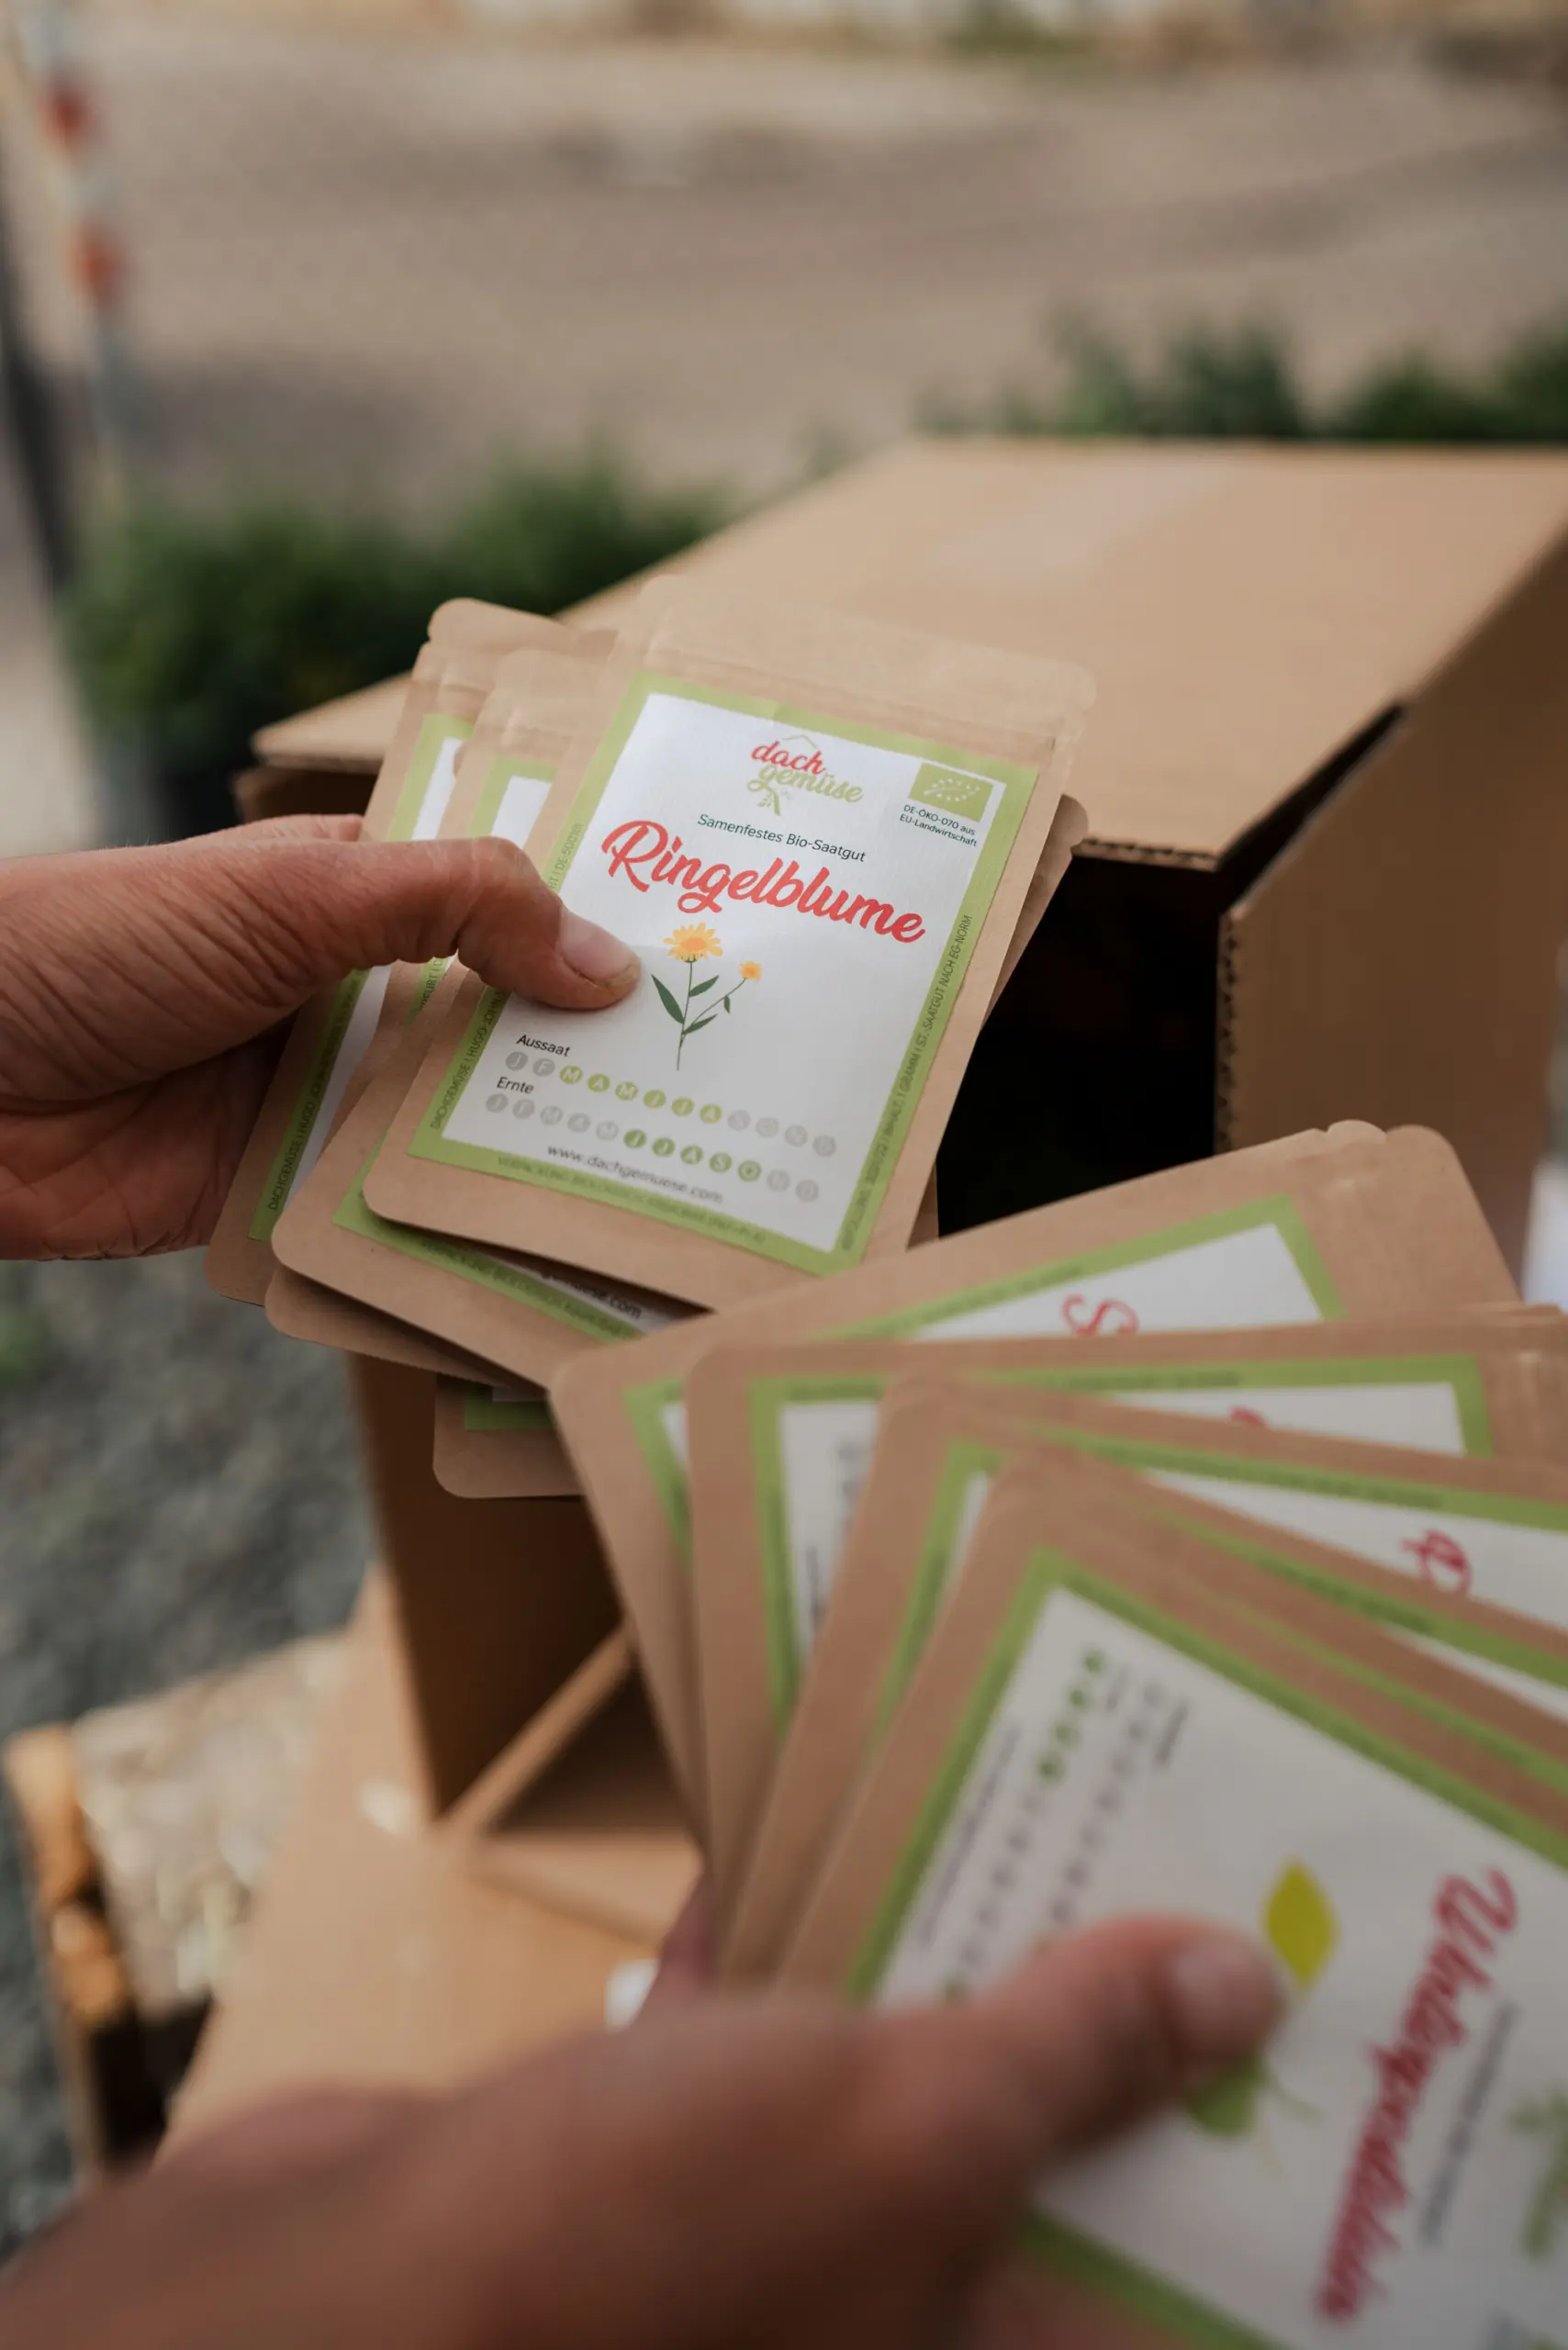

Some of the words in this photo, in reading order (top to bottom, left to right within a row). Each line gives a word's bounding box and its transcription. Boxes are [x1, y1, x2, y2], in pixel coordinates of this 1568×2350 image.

[751, 741, 826, 775] dach
[746, 763, 863, 804] gemüse
[900, 813, 978, 846] EU-Landwirtschaft
[903, 804, 958, 829] DE-ÖKO-070
[959, 824, 975, 835] aus
[698, 814, 782, 843] Samenfestes
[786, 834, 866, 862] Bio-Saatgut
[601, 820, 926, 943] Ringelblume
[922, 987, 945, 1030] SAATGUT
[938, 958, 956, 987] NACH
[948, 914, 972, 959] EG-NORM
[516, 1034, 571, 1057] Aussaat
[497, 1077, 533, 1094] Ernte
